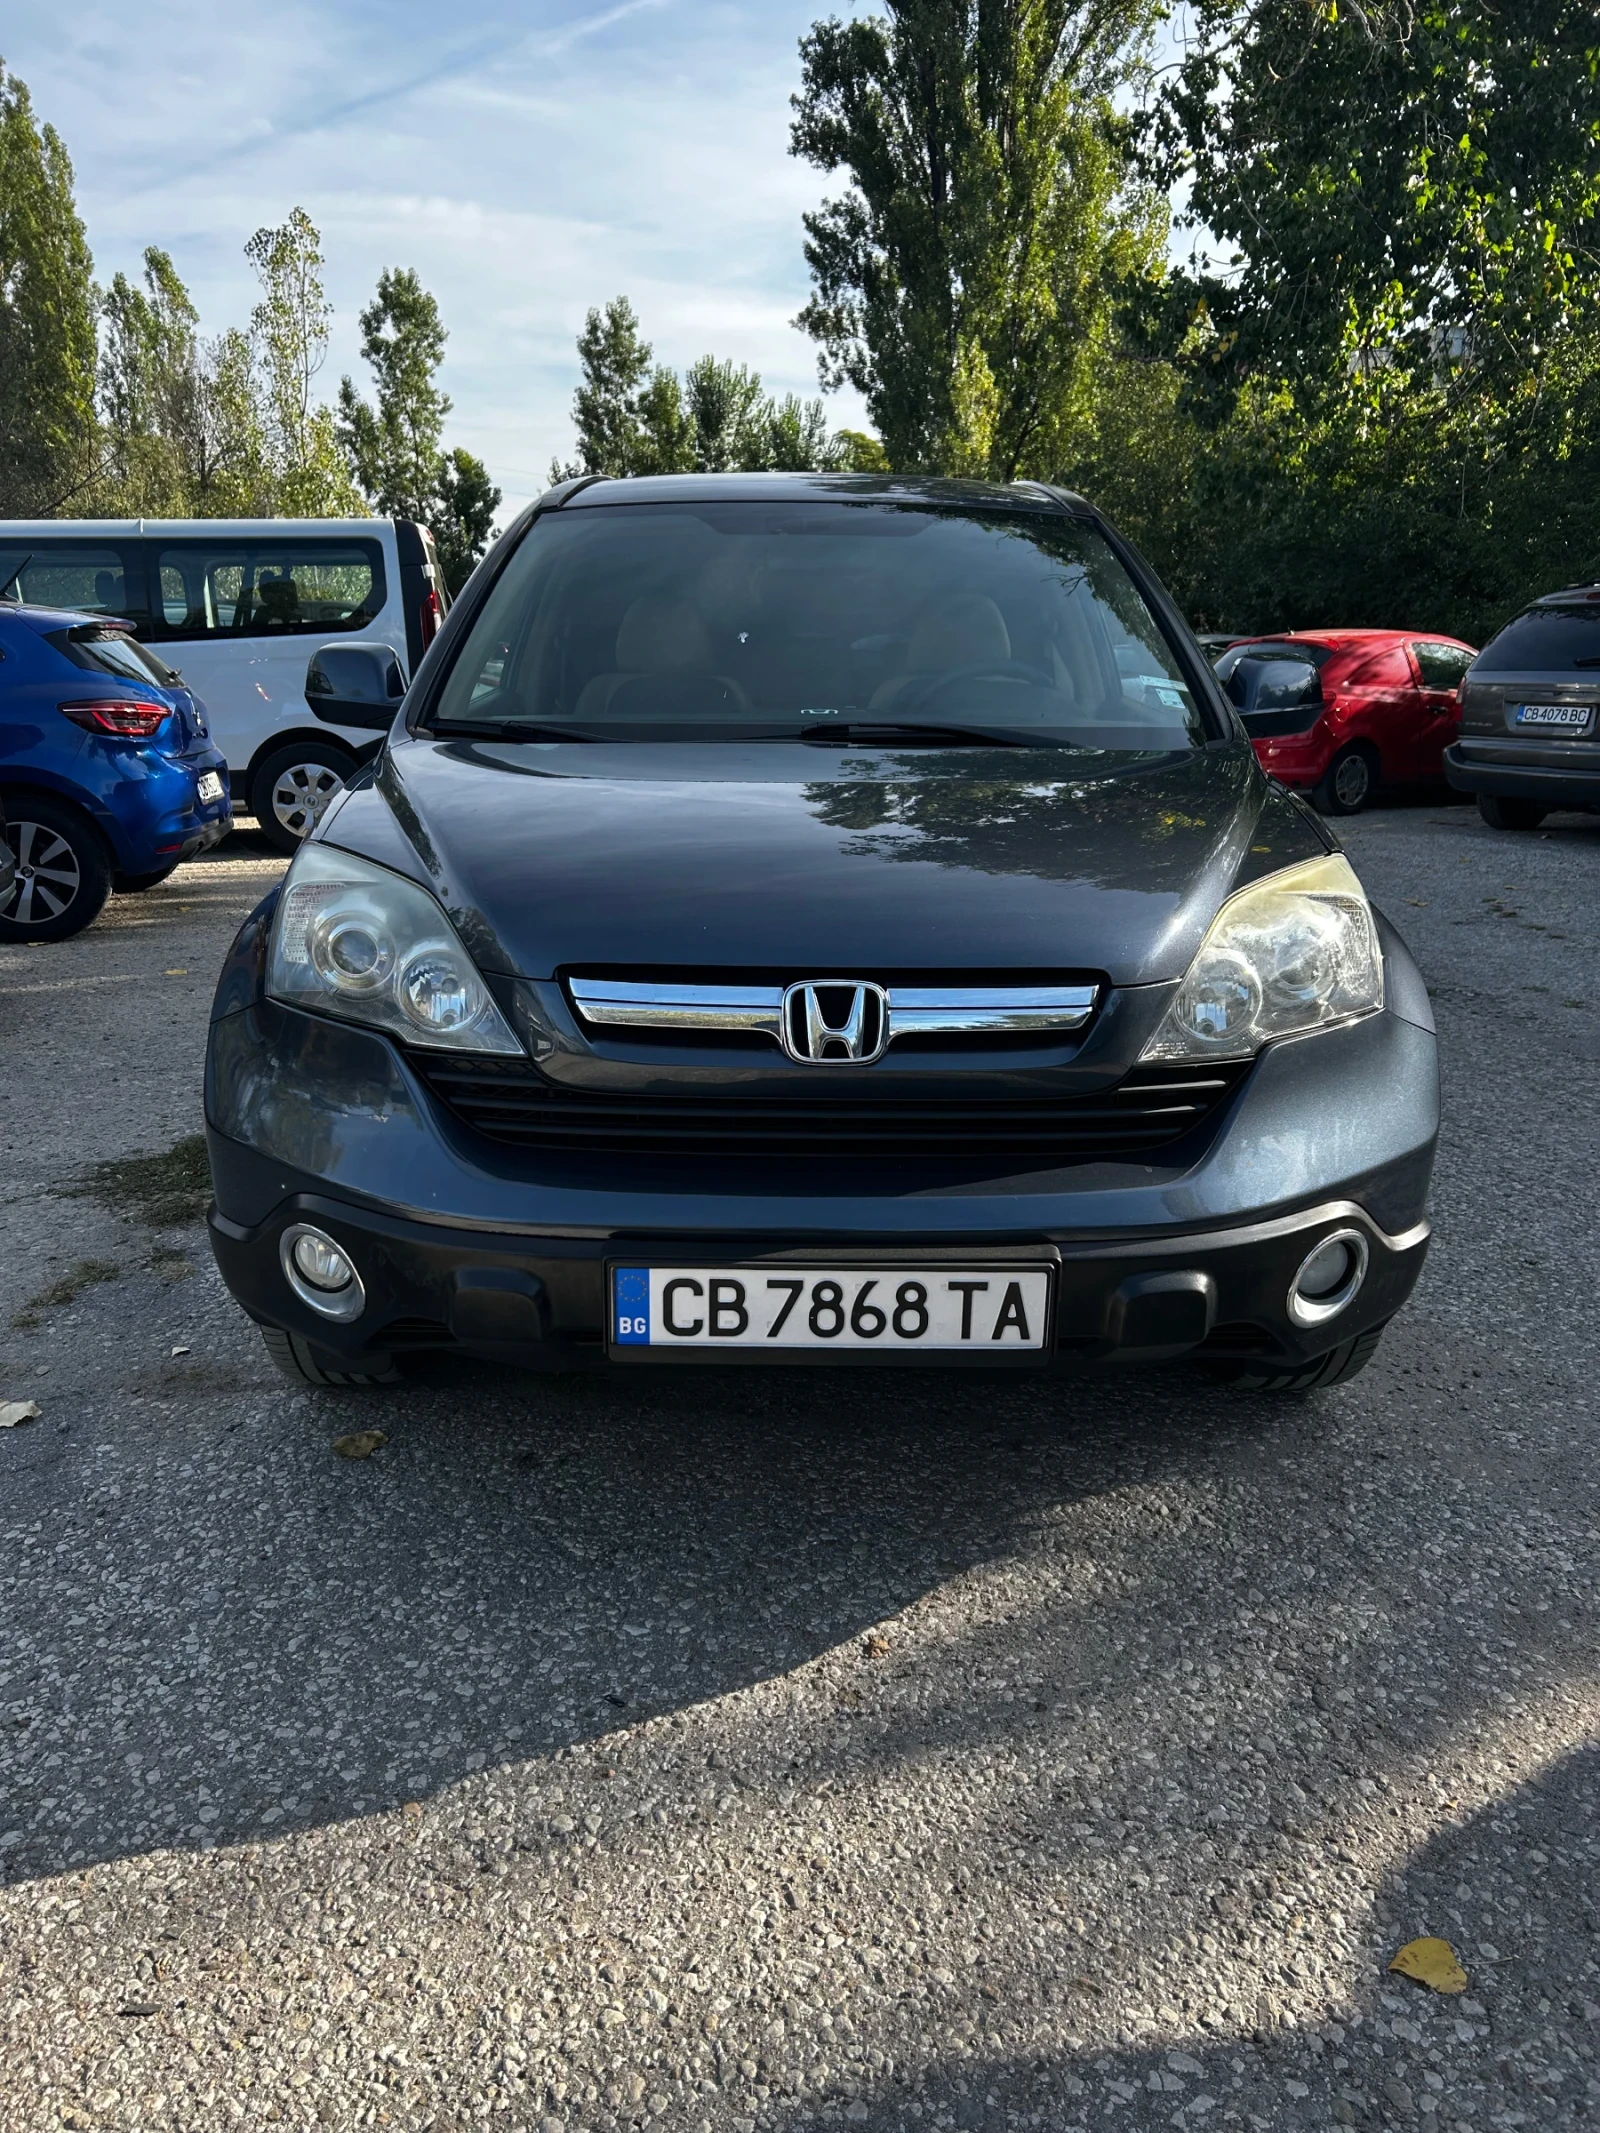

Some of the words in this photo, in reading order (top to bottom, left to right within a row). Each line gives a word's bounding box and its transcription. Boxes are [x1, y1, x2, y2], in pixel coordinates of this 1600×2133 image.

[1524, 707, 1539, 720] CB
[1539, 708, 1568, 721] 4078
[662, 1278, 749, 1337] CB
[766, 1279, 929, 1340] 7868
[947, 1281, 1031, 1341] TA
[619, 1316, 646, 1334] BG
